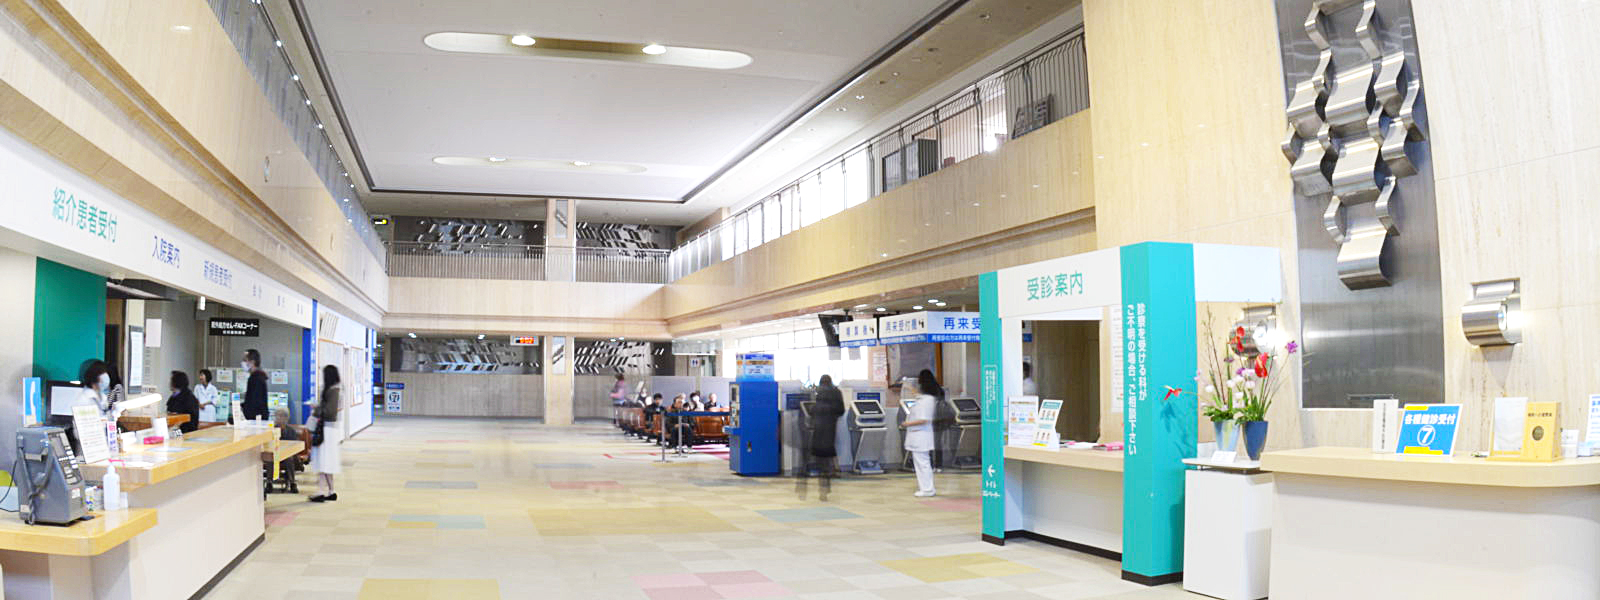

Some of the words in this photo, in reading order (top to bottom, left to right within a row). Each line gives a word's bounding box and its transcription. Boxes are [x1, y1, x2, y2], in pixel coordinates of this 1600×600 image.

[51, 187, 117, 243] 紹介患者受付
[152, 235, 180, 269] 入院案内
[1027, 269, 1084, 302] 受診案内
[1136, 303, 1147, 401] 診察を受ける科が
[1405, 413, 1456, 425] 各種健診受付
